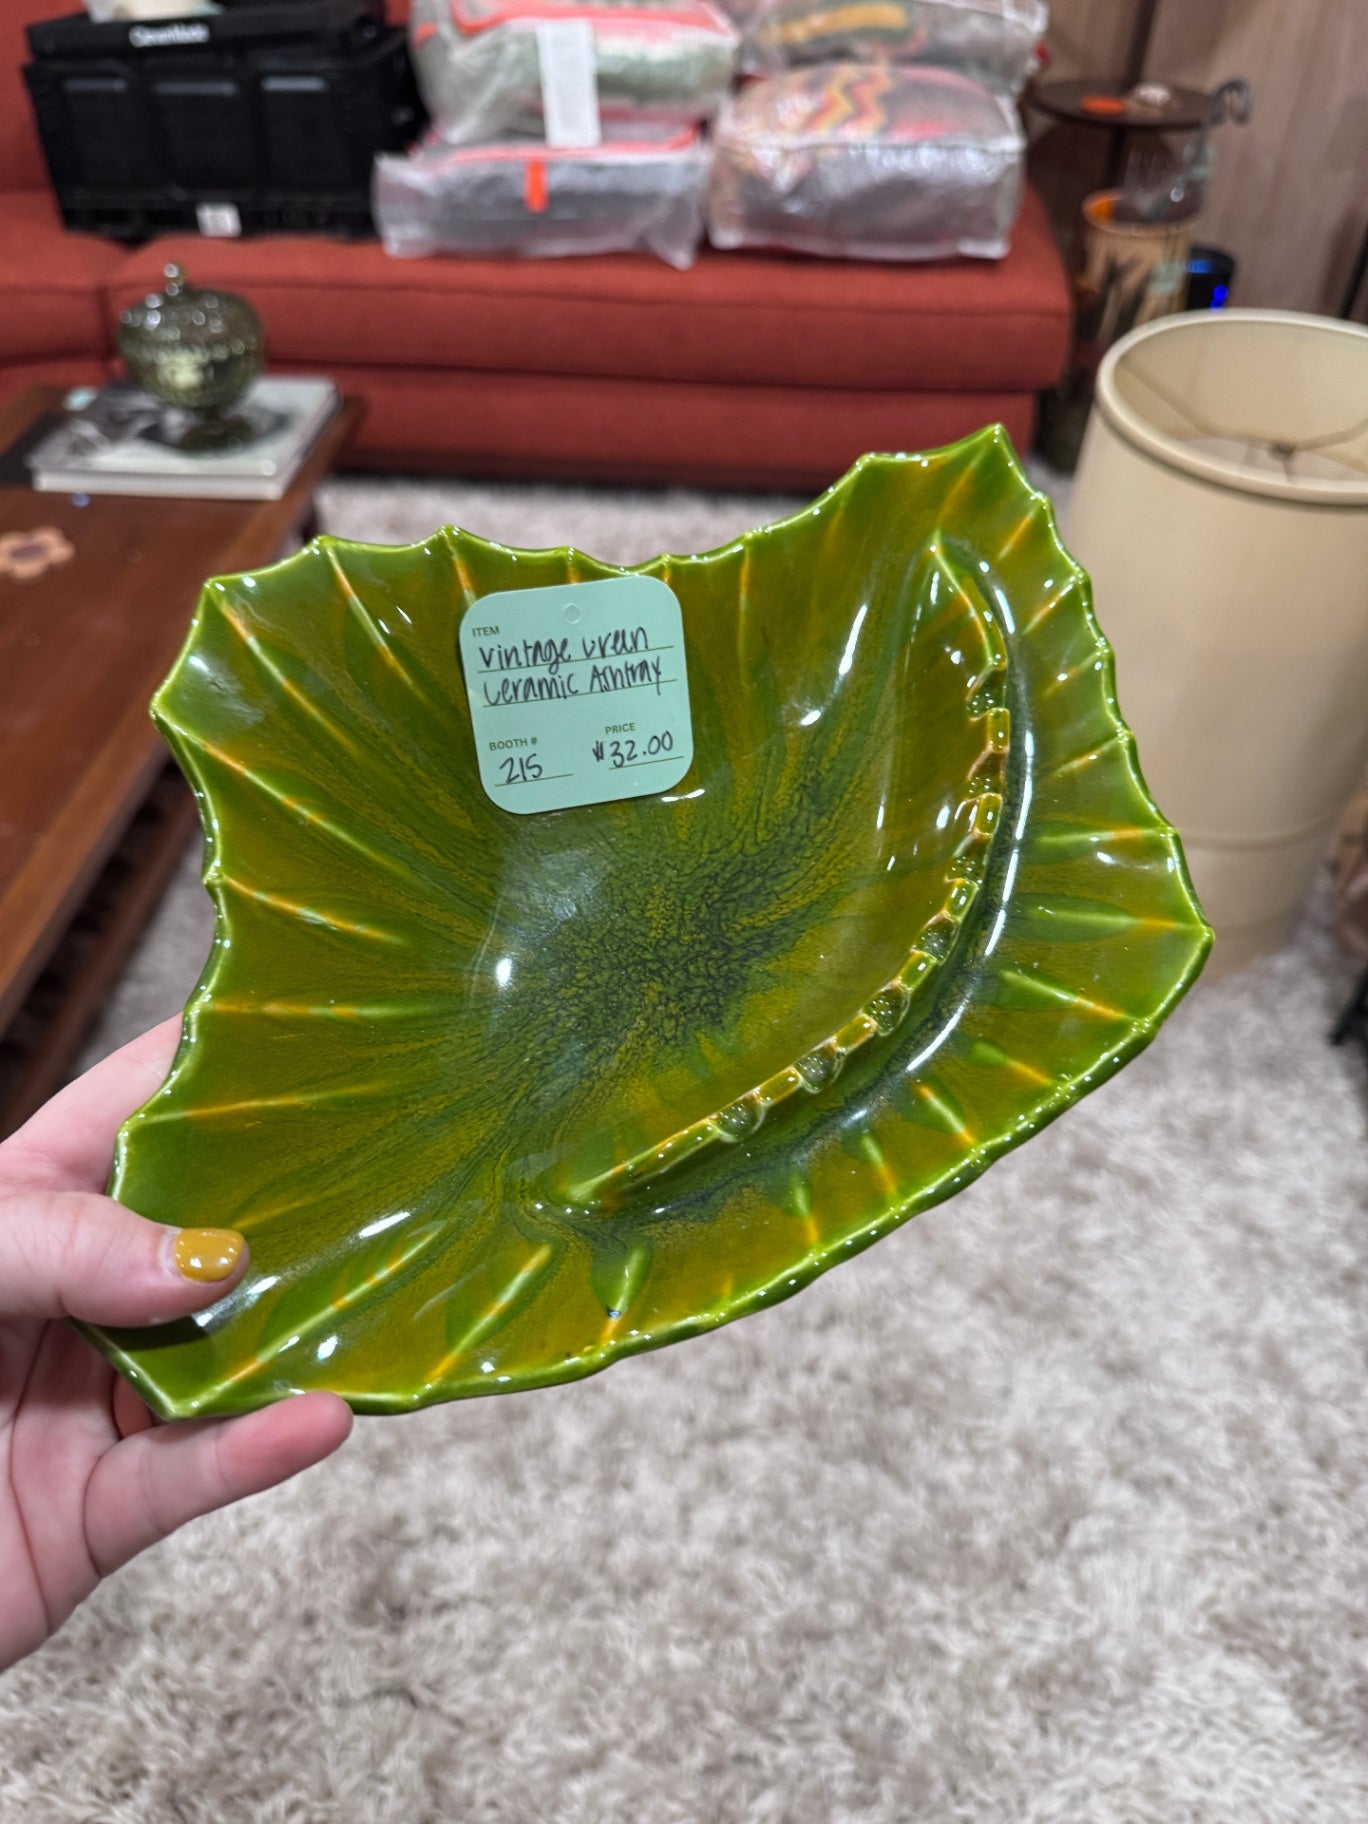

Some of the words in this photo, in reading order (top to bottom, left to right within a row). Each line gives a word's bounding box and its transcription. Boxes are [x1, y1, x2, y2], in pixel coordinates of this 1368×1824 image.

[472, 626, 500, 637] ITEM
[605, 722, 636, 735] PRICE
[489, 738, 528, 751] BOOTH
[531, 737, 538, 746] #
[499, 753, 543, 785] 215
